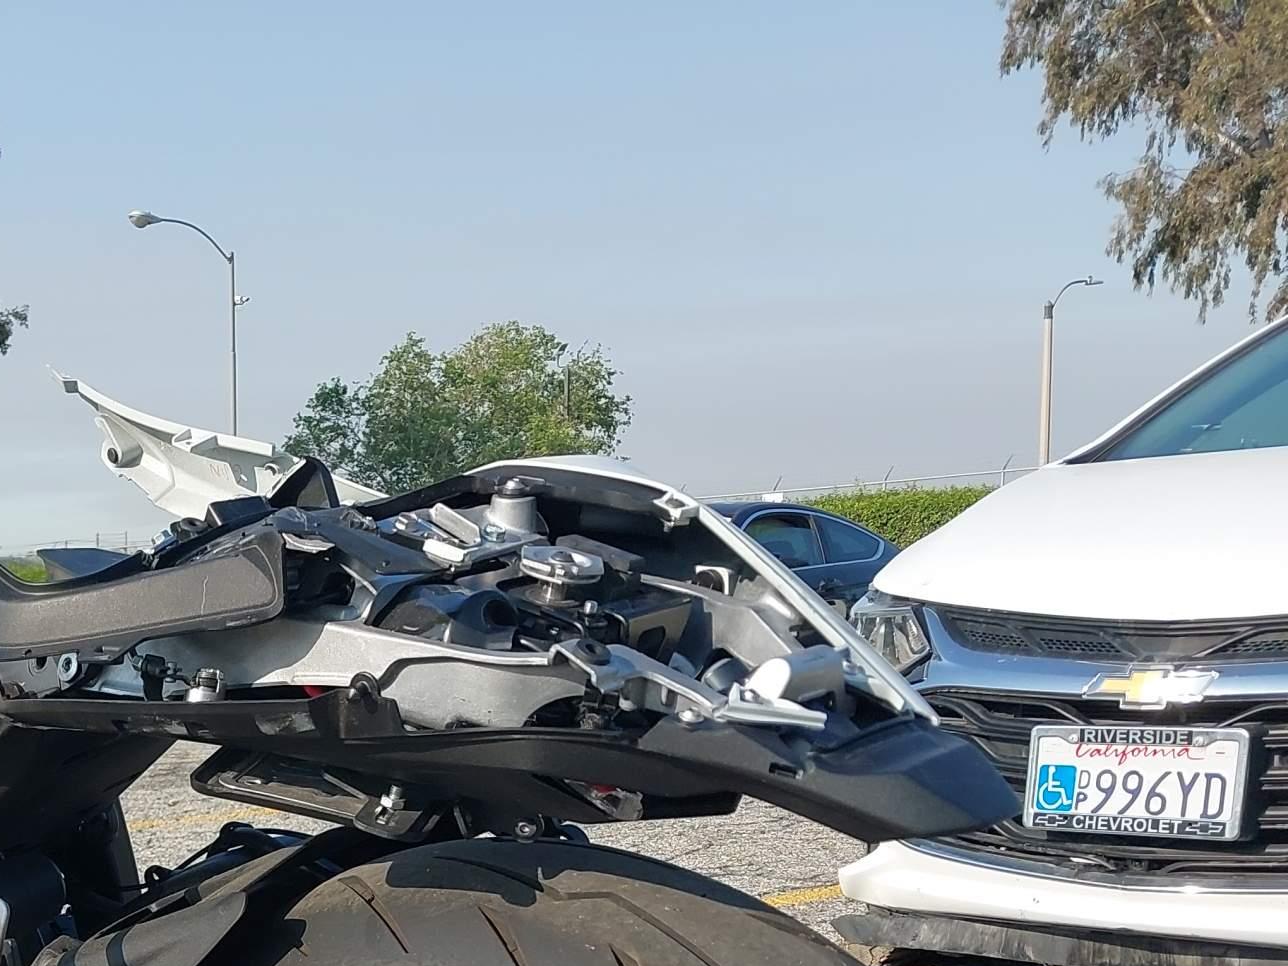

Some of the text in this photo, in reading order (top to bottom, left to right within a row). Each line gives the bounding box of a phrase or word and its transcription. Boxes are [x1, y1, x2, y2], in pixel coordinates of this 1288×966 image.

[1083, 729, 1190, 746] RIVERSIDE
[1075, 743, 1205, 766] California
[1090, 769, 1227, 819] 996YD
[1072, 815, 1182, 833] CHEVROLET
